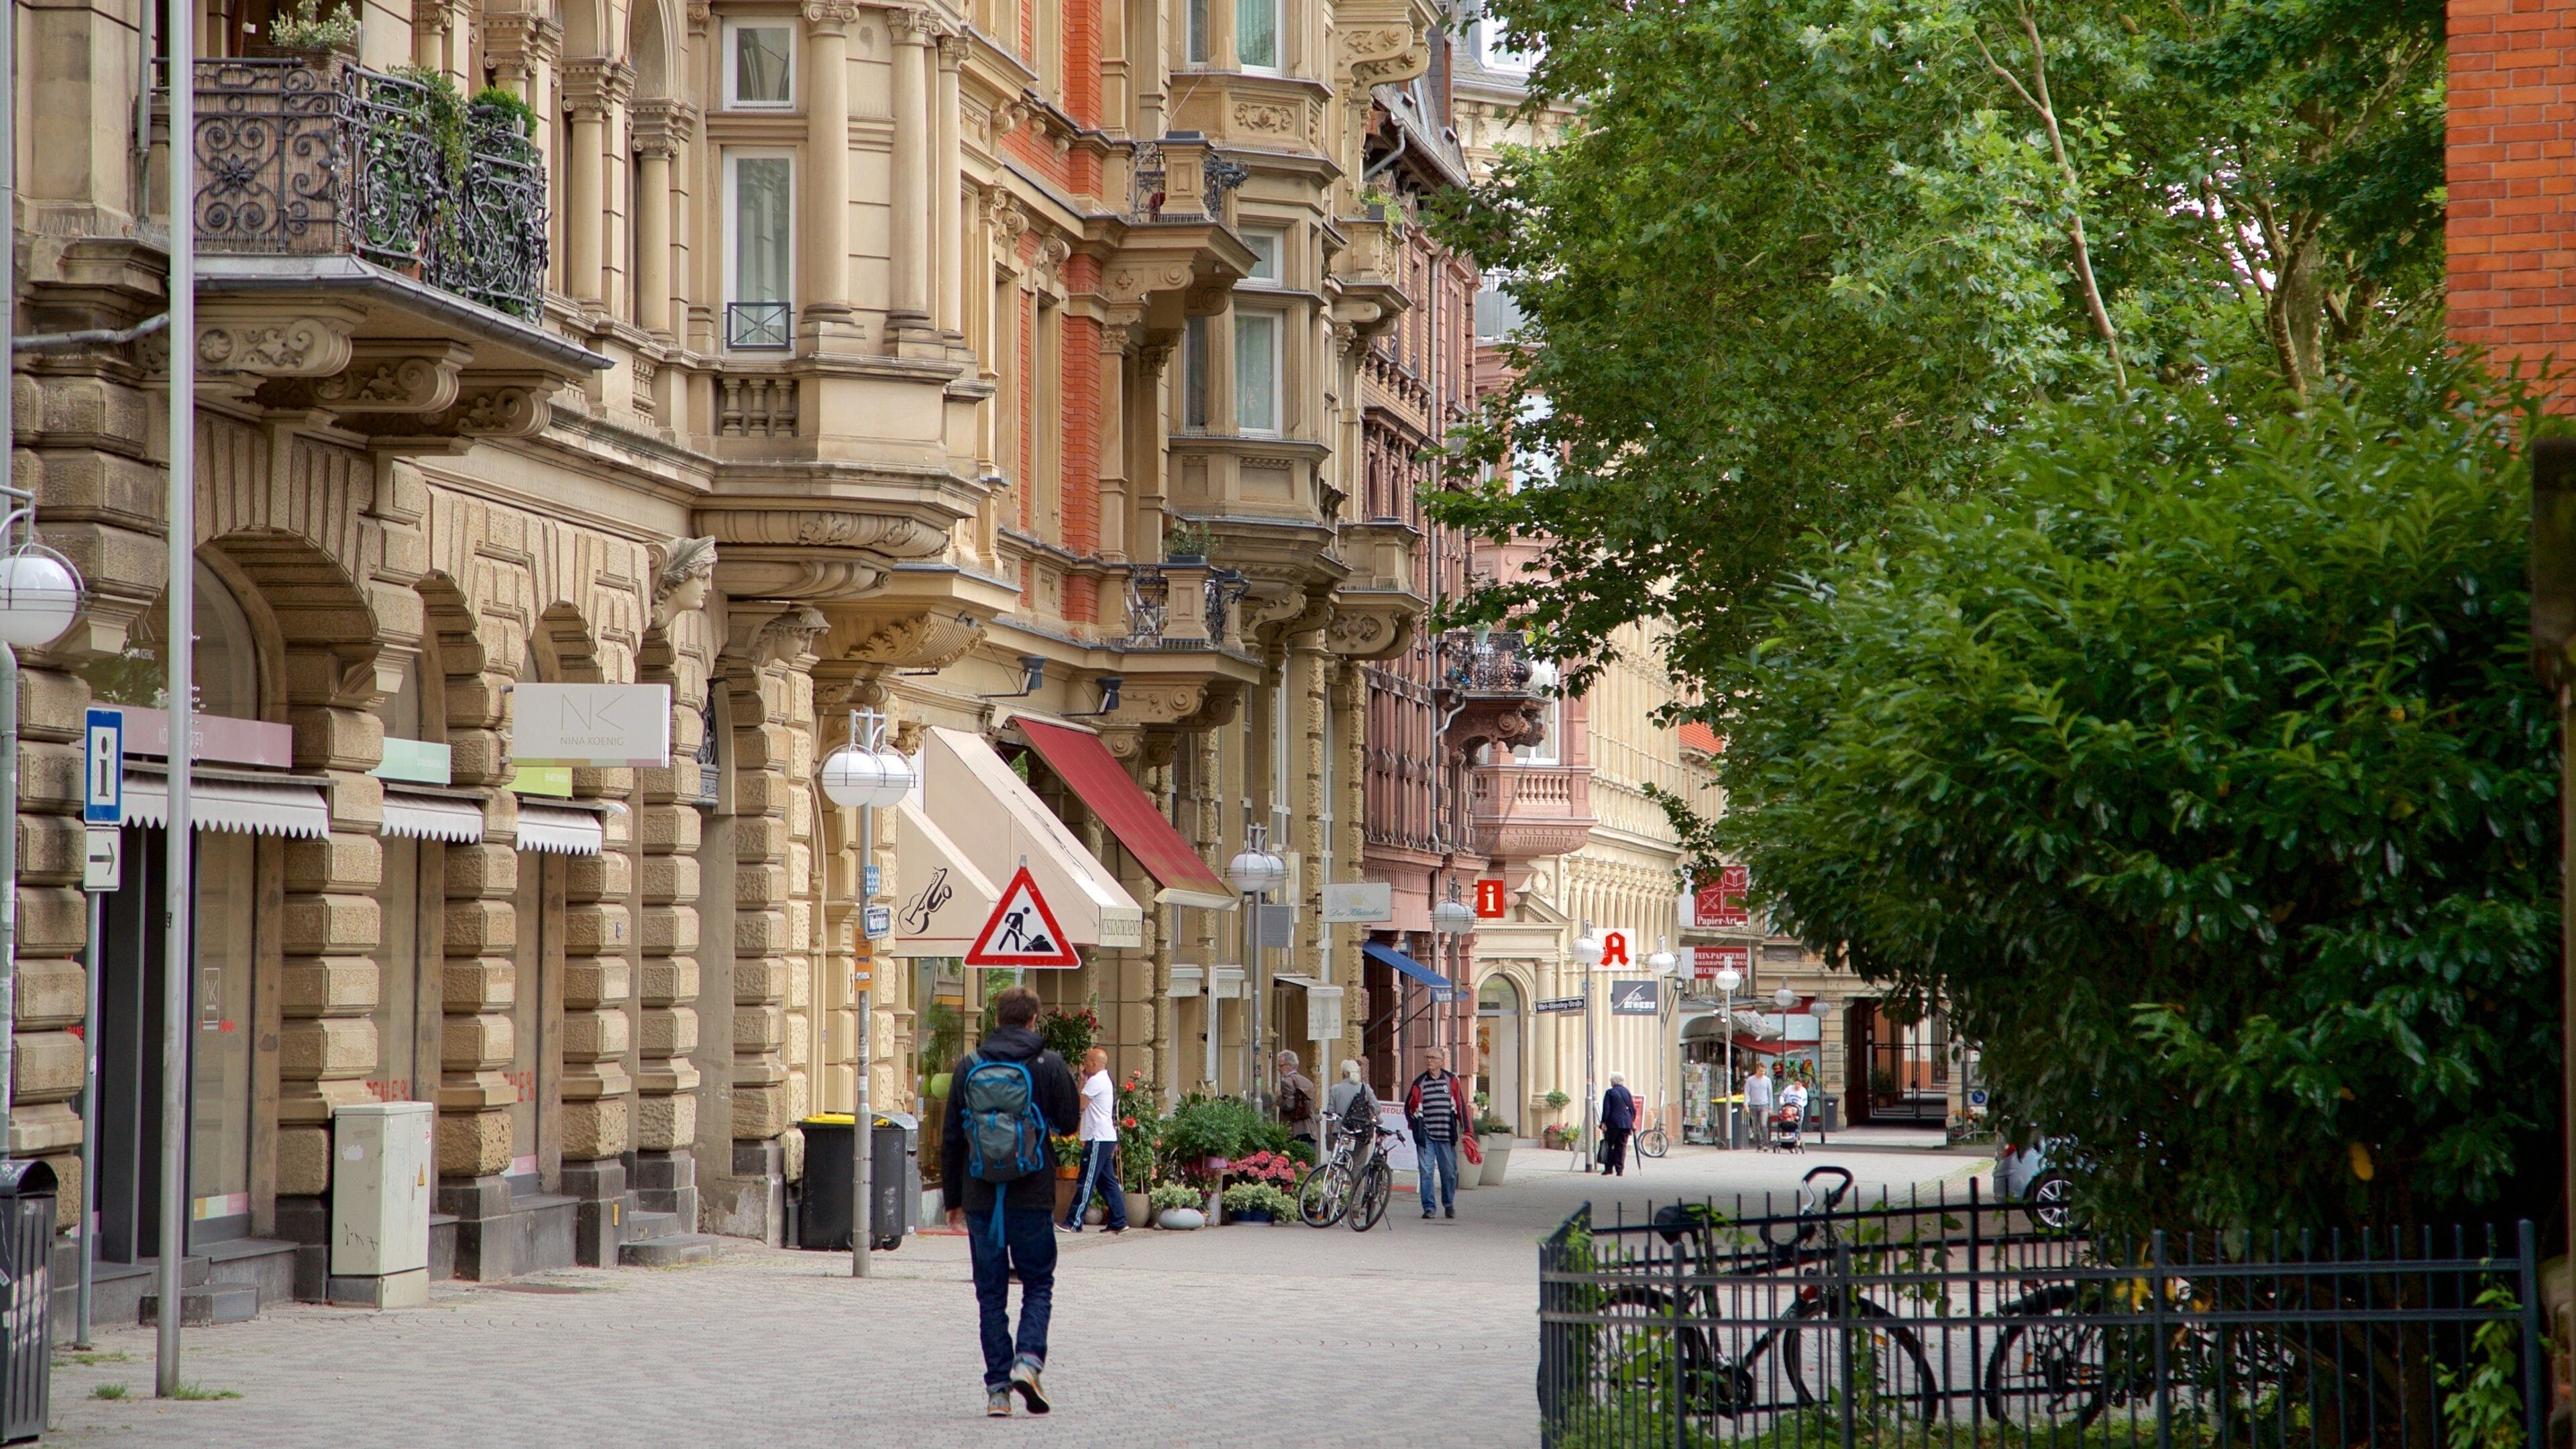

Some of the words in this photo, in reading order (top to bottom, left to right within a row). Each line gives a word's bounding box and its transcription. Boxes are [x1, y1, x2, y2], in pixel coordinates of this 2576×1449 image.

[561, 692, 625, 731] NK
[560, 736, 586, 745] NINA
[587, 736, 625, 746] KOENIG
[1601, 931, 1629, 966] A
